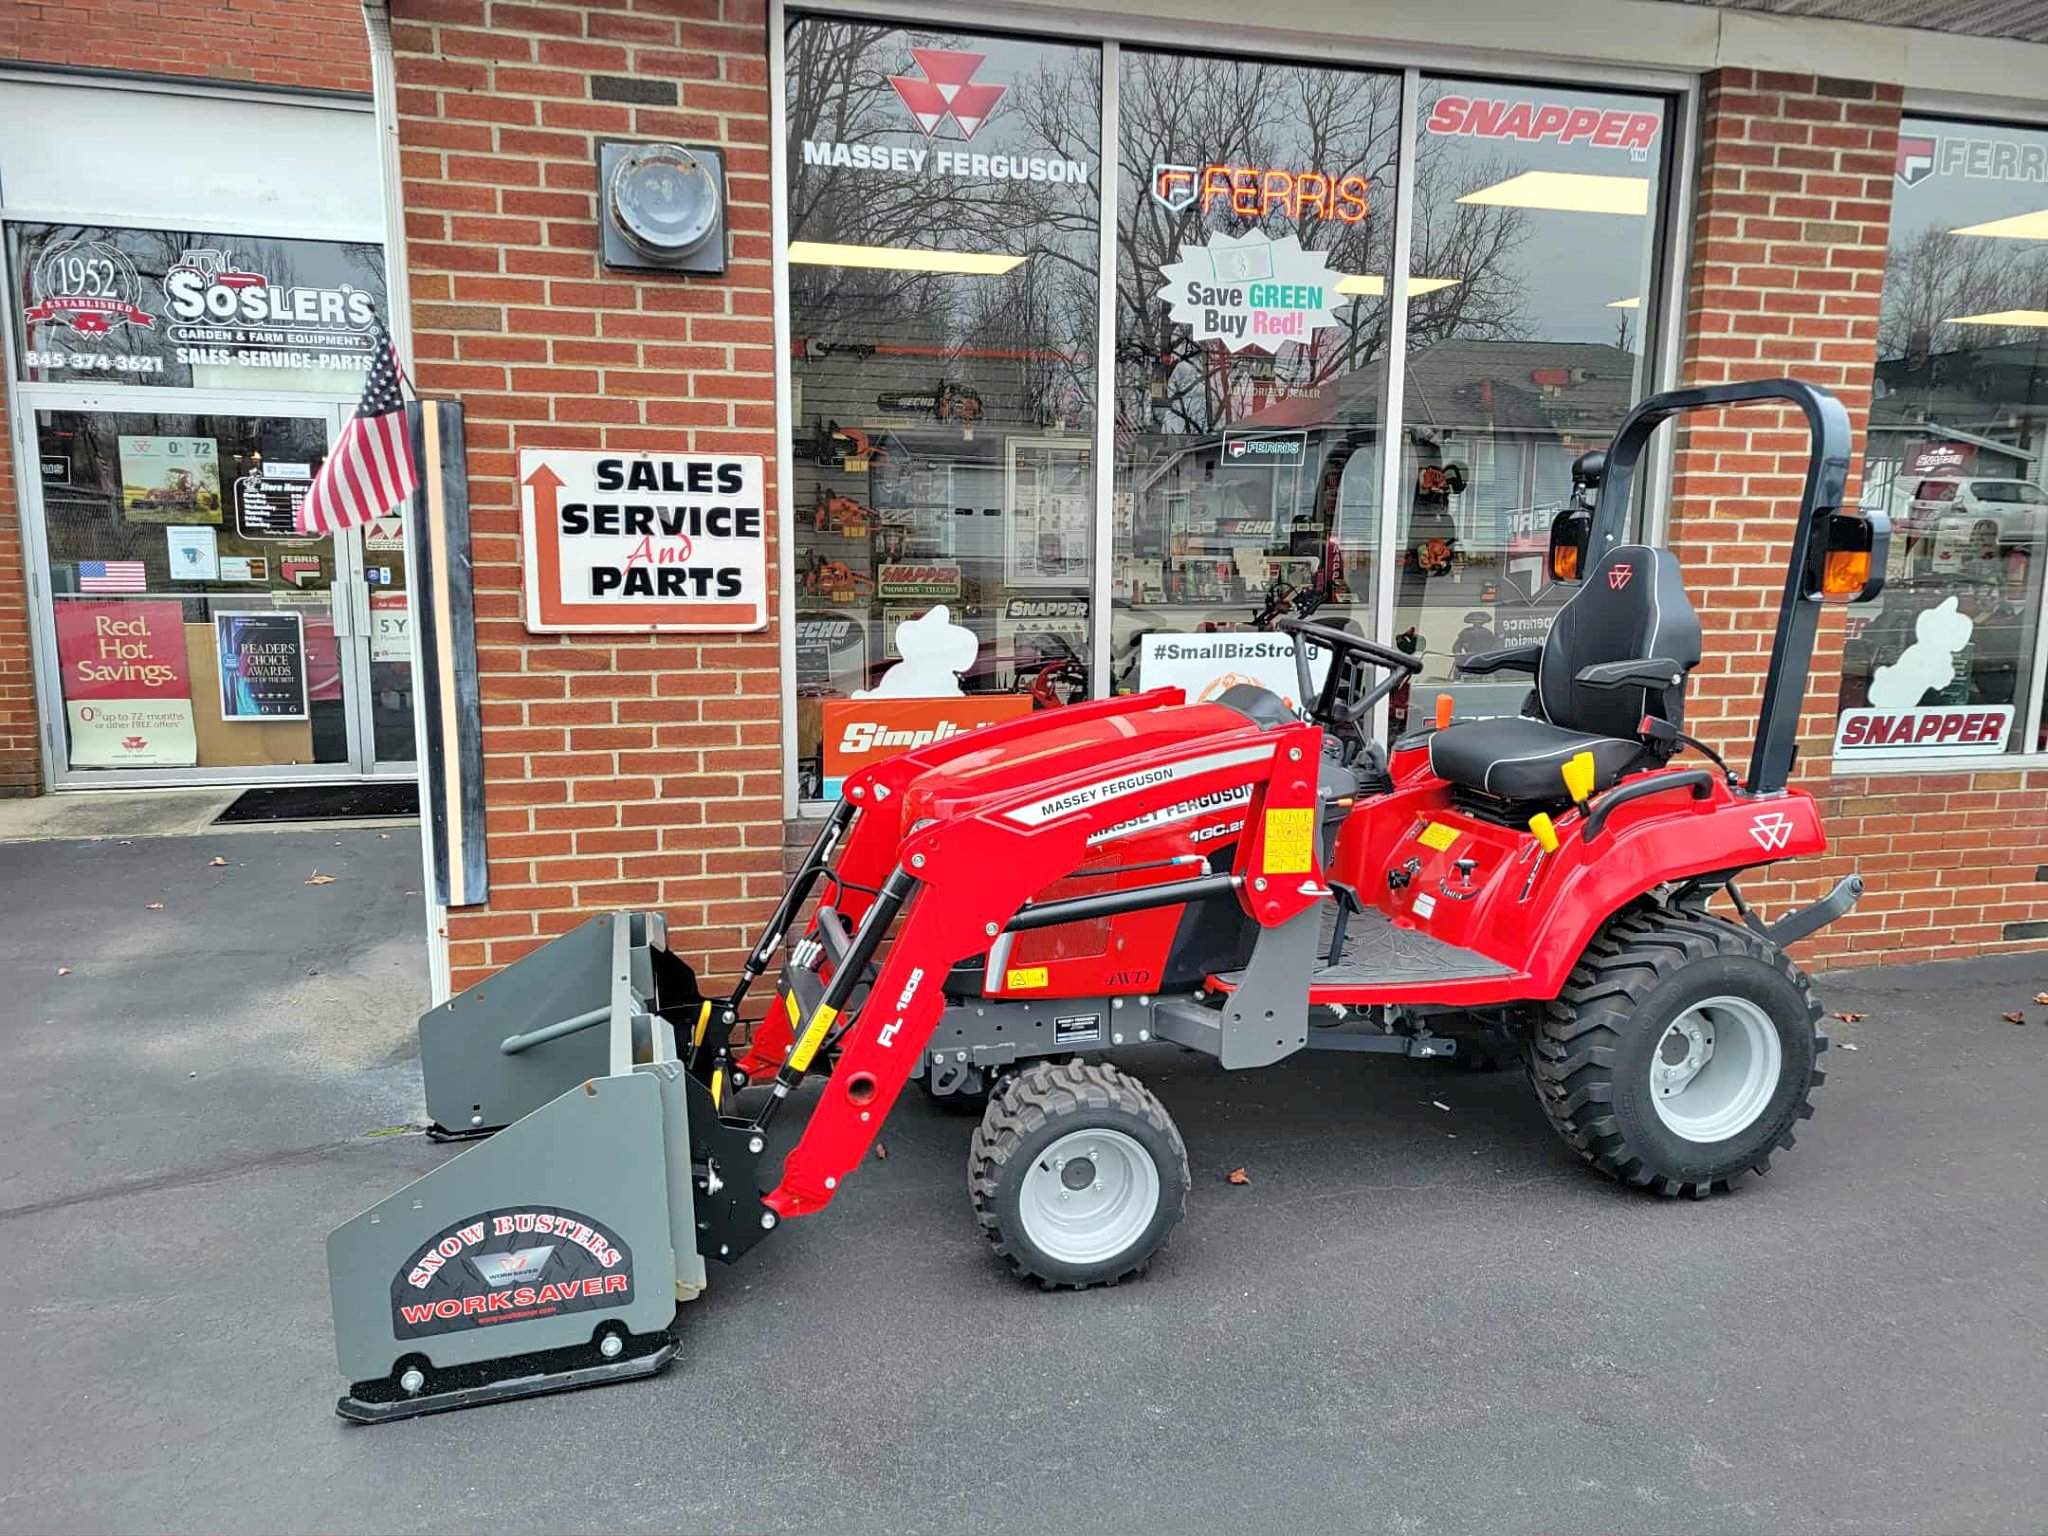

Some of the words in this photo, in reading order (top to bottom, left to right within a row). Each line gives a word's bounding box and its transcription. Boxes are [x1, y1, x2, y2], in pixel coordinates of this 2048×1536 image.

[1426, 96, 1660, 150] SNAPPER
[802, 140, 928, 173] MASSEY
[937, 151, 1089, 184] FERGUSON
[1940, 136, 2048, 183] FERR
[1202, 164, 1369, 224] FERRIS
[57, 257, 118, 297] 1952
[46, 299, 133, 313] ESTABLISHED
[1187, 281, 1243, 307] Save
[1249, 284, 1323, 310] GREEN
[1204, 309, 1248, 339] Buy
[1253, 311, 1304, 335] Red!
[178, 329, 232, 342] GARDEN
[235, 333, 246, 343] &
[249, 333, 284, 344] FARM
[287, 336, 361, 347] EQUIPMENT
[192, 442, 211, 455] 72
[1246, 441, 1299, 454] FERRIS
[596, 459, 743, 495] SALES
[561, 503, 761, 539] SERVICE
[1234, 520, 1276, 534] ECHO
[280, 554, 320, 564] FERRIS
[622, 533, 693, 576] And
[590, 566, 742, 598] PARTS
[880, 566, 960, 584] SNAPPER
[1009, 600, 1090, 617] SNAPPER
[95, 615, 152, 636] Red.
[796, 622, 851, 638] ECHO
[98, 638, 153, 660] Hot.
[247, 655, 289, 666] CHOICE
[1153, 642, 1319, 660] #SmallBizStrog
[77, 661, 179, 687] Savings.
[247, 666, 292, 676] AWARDS
[1841, 713, 2007, 745] SNAPPER
[1041, 787, 1098, 817] MASSEY
[1101, 768, 1175, 798] FERGUSON
[1188, 820, 1247, 843] 1GC.2
[876, 1017, 904, 1048] FL
[407, 1221, 485, 1290] SNOW
[493, 1212, 623, 1270] BUSTERS
[400, 1274, 629, 1325] WORKSAVER
